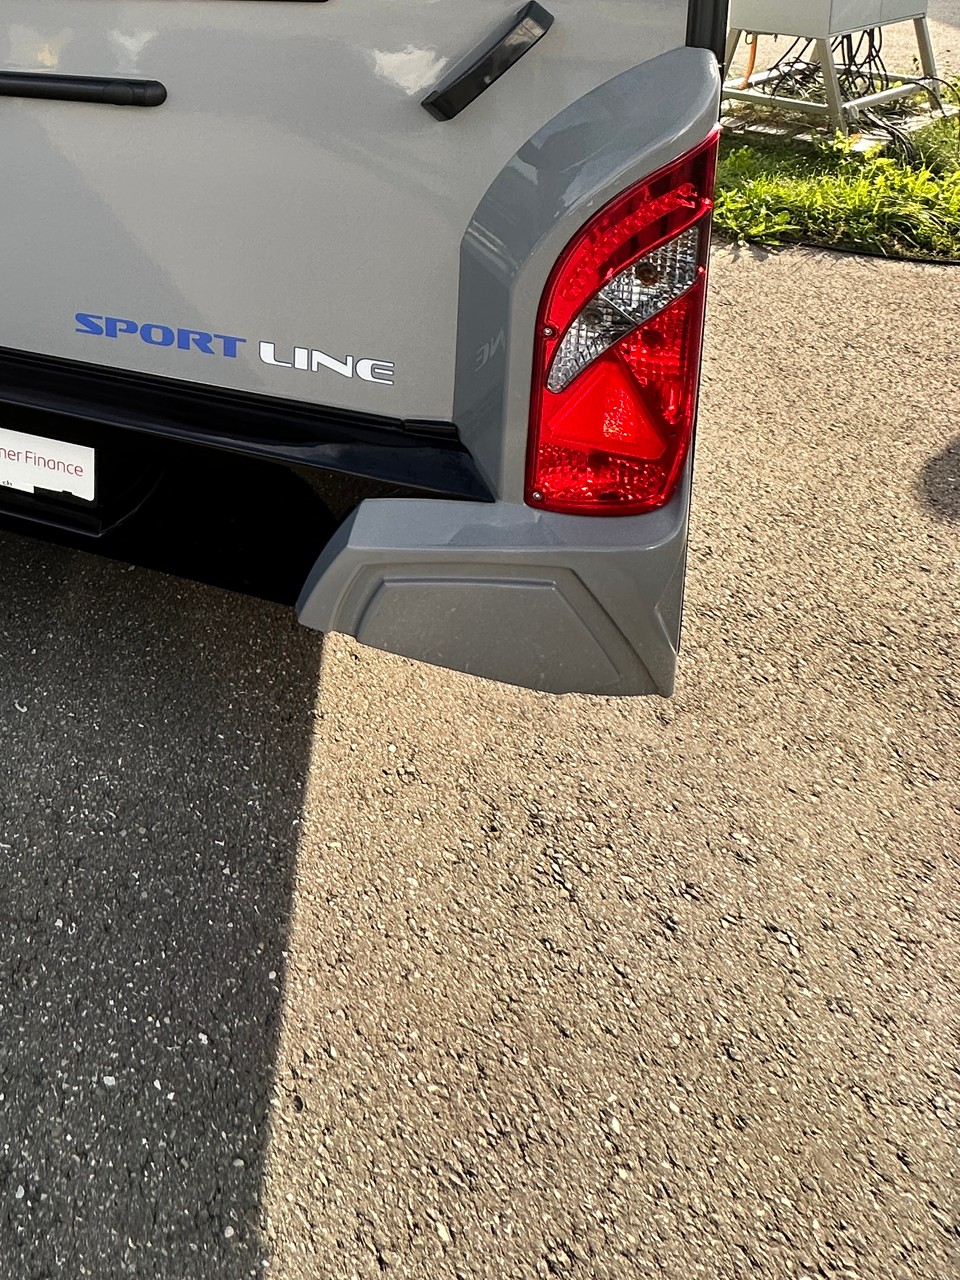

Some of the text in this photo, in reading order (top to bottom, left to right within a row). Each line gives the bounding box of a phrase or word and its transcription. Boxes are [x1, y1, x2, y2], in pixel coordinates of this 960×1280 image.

[74, 312, 394, 385] SPORT LINE
[25, 450, 84, 477] Finance
